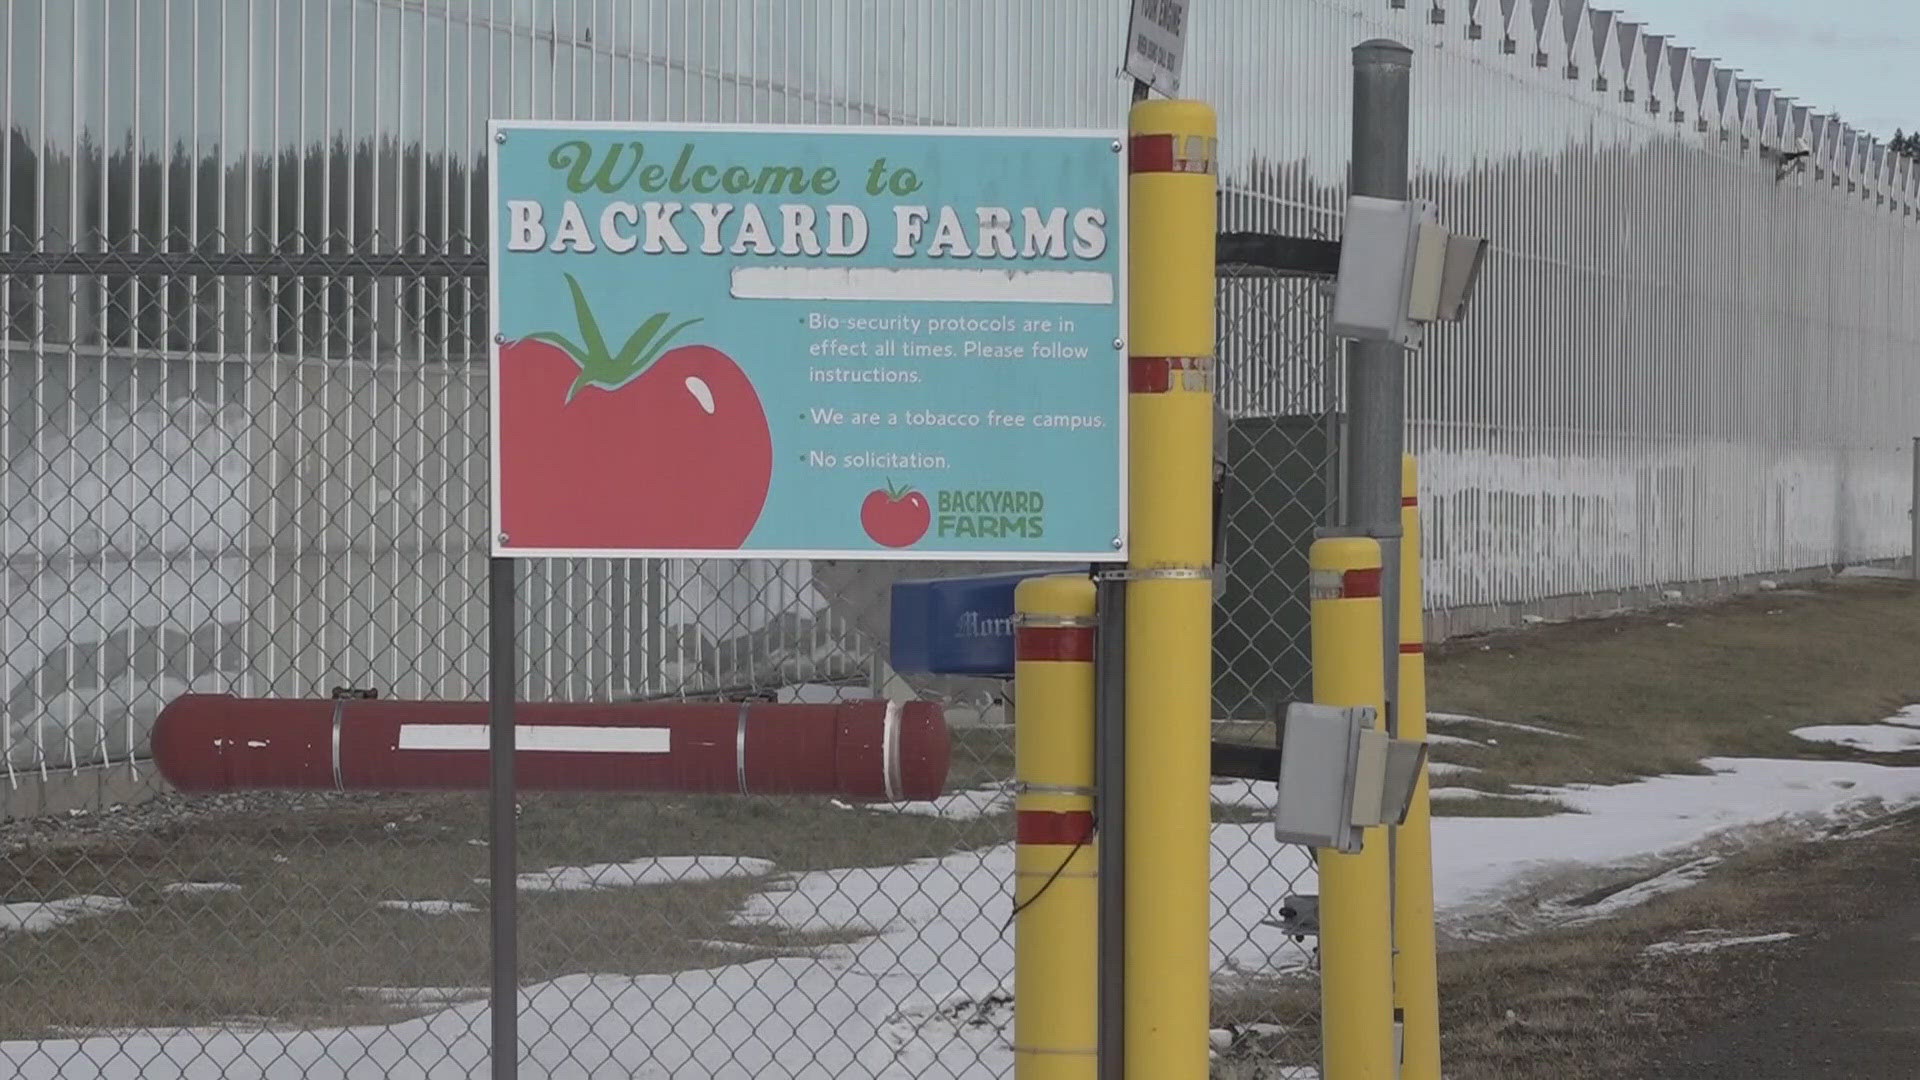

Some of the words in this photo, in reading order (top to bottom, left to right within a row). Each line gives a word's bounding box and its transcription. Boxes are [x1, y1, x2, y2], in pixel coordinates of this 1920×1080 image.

[548, 141, 840, 195] Welcome
[865, 157, 923, 196] to
[507, 200, 869, 256] BACKYARD
[892, 204, 1107, 260] FARMS
[928, 316, 1016, 334] protocols
[1023, 320, 1052, 332] are
[1058, 316, 1075, 333] in
[809, 340, 867, 357] effect
[874, 340, 895, 357] all
[902, 341, 957, 358] times.
[964, 341, 1025, 359] Please
[1031, 342, 1089, 360] follow
[809, 366, 922, 384] instructions.
[810, 408, 844, 426] We
[851, 411, 881, 426] are
[888, 412, 898, 426] a
[905, 410, 980, 428] tobacco
[987, 410, 1026, 428] free
[1032, 413, 1107, 432] campus.
[809, 451, 837, 468] No
[843, 451, 951, 470] solicitation.
[938, 490, 1044, 514] BACKYARD
[938, 516, 1044, 538] FARMS
